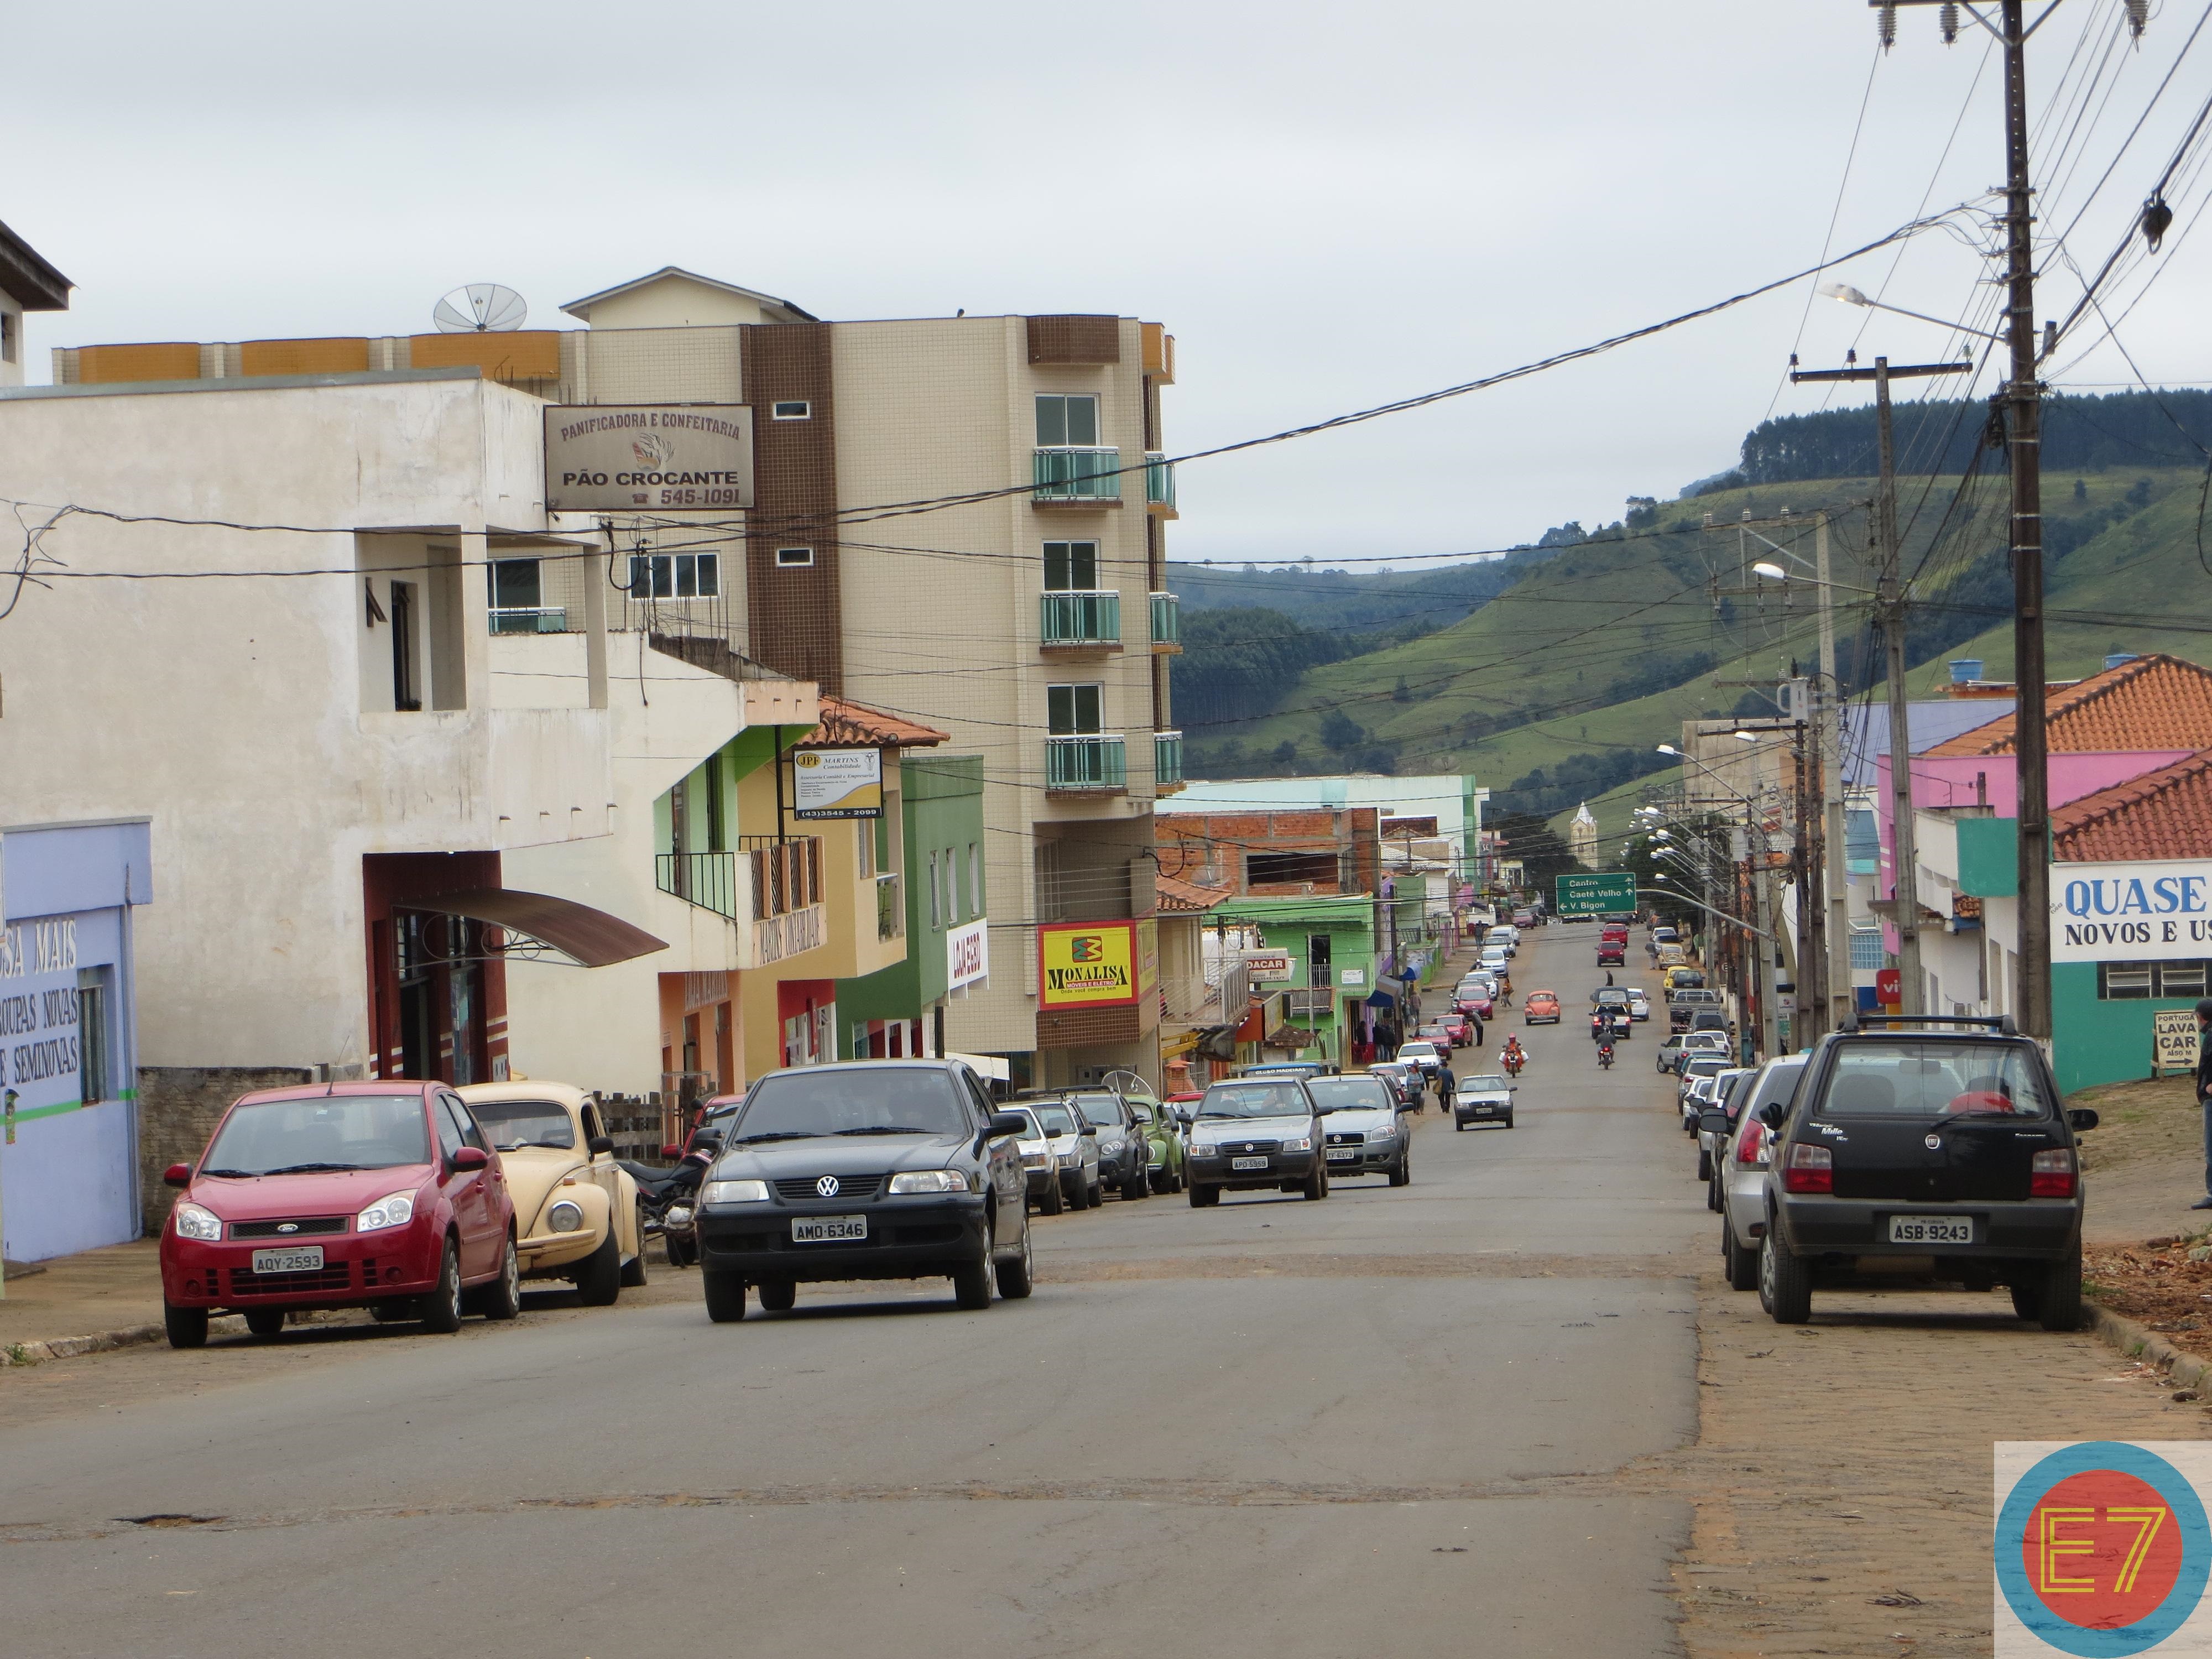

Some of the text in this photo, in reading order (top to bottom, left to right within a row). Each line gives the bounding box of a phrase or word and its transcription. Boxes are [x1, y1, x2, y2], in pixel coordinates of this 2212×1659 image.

[561, 413, 739, 441] PANIFICADORA E CONFEITARIA
[563, 469, 738, 486] PÃO CROCANTE
[661, 489, 739, 504] 545-1091
[801, 757, 820, 765] JPF
[1580, 901, 1605, 910] Bigon
[2065, 876, 2207, 919] QUASE
[2064, 922, 2151, 946] NOVOS
[2162, 921, 2178, 942] E
[0, 919, 76, 979] SA MAIS
[953, 938, 967, 979] LOJA
[1247, 959, 1283, 969] DACAR
[1048, 965, 1128, 990] MONALISA
[1883, 979, 1901, 993] vi
[43, 987, 78, 1029] NOVAS
[2158, 1023, 2197, 1034] LAVA
[2159, 1036, 2197, 1048] CAR
[15, 1035, 78, 1084] SEMINOVAS
